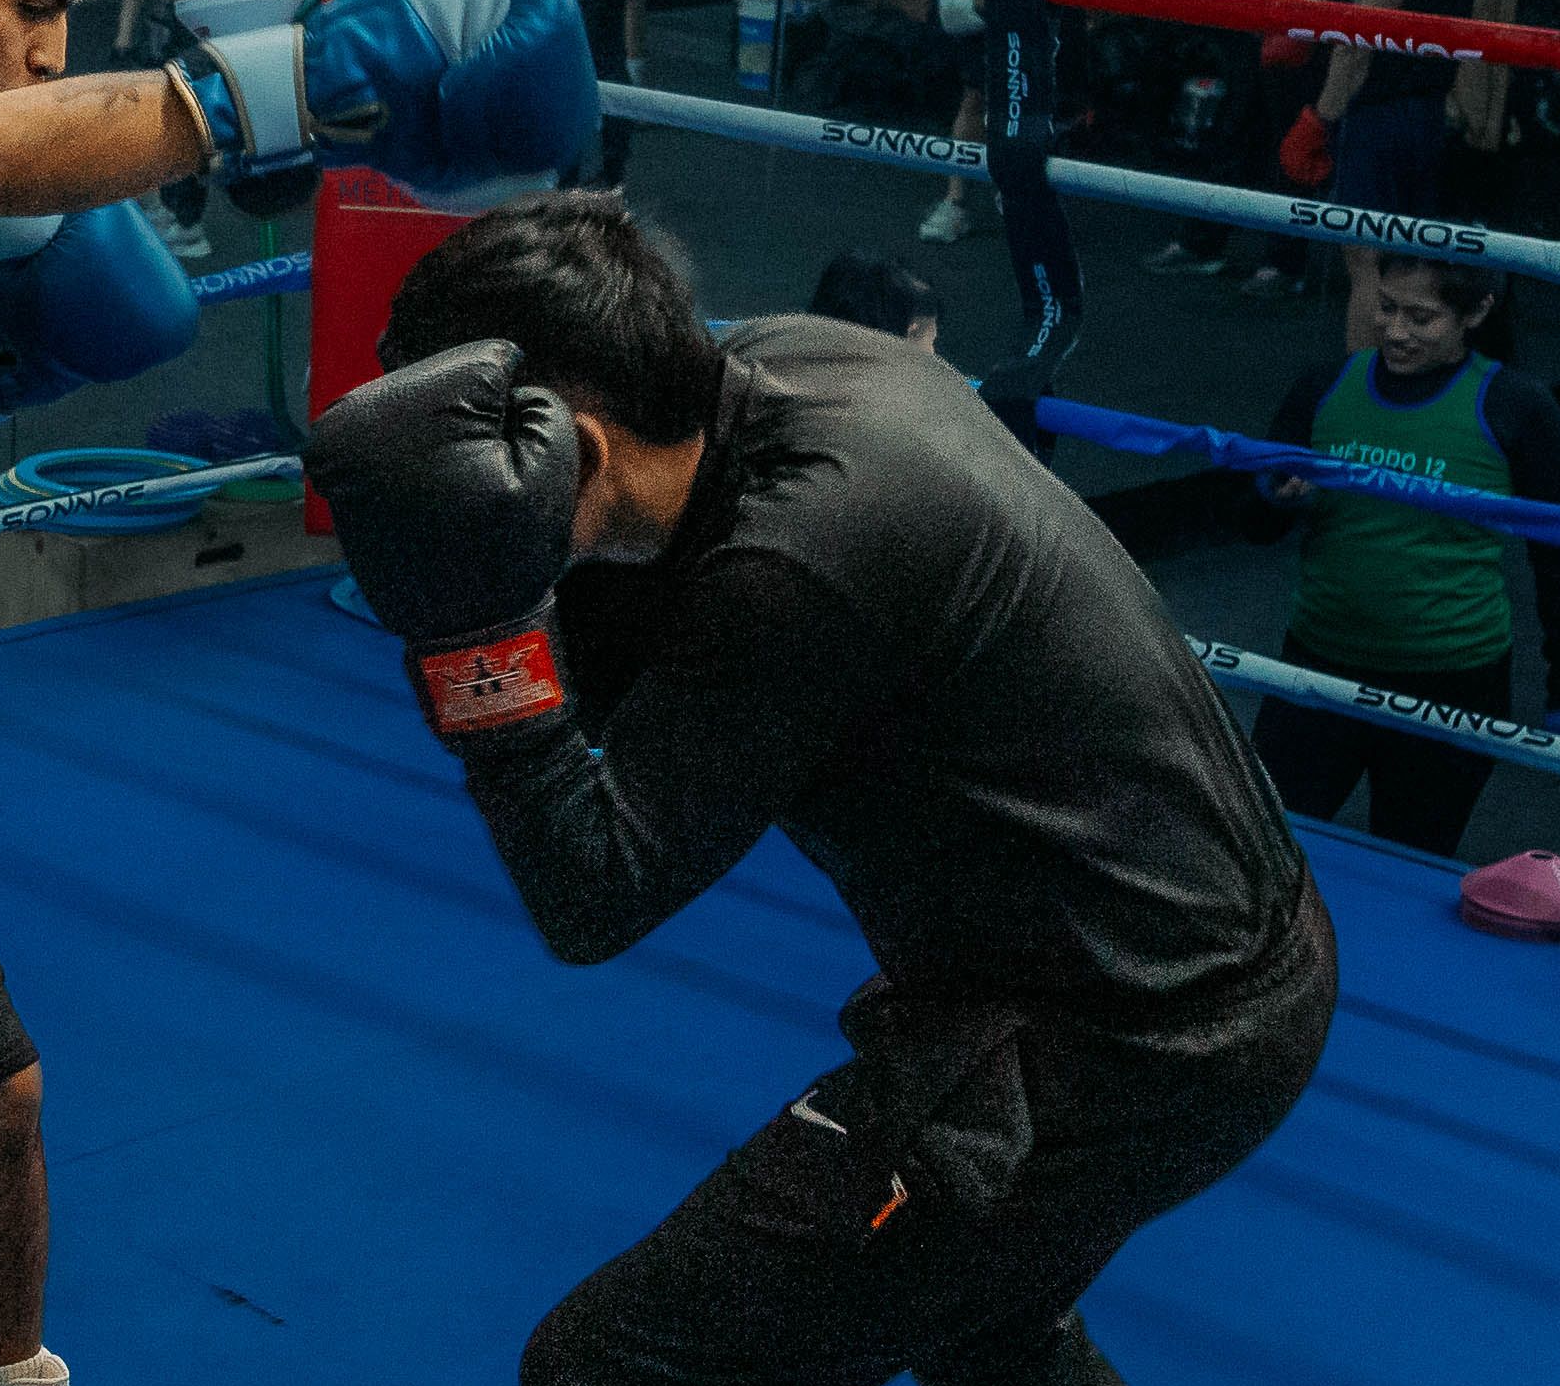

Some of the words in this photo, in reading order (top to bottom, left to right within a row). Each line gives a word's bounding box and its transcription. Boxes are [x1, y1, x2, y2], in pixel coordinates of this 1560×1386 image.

[1007, 31, 1021, 137] SONNOS
[821, 121, 982, 165] SONNOS
[1290, 202, 1486, 254] SONNOS
[1027, 262, 1058, 358] SONNOS
[1425, 457, 1447, 476] 12
[1, 484, 146, 531] SONNOS
[1354, 683, 1556, 747] SONNOS
